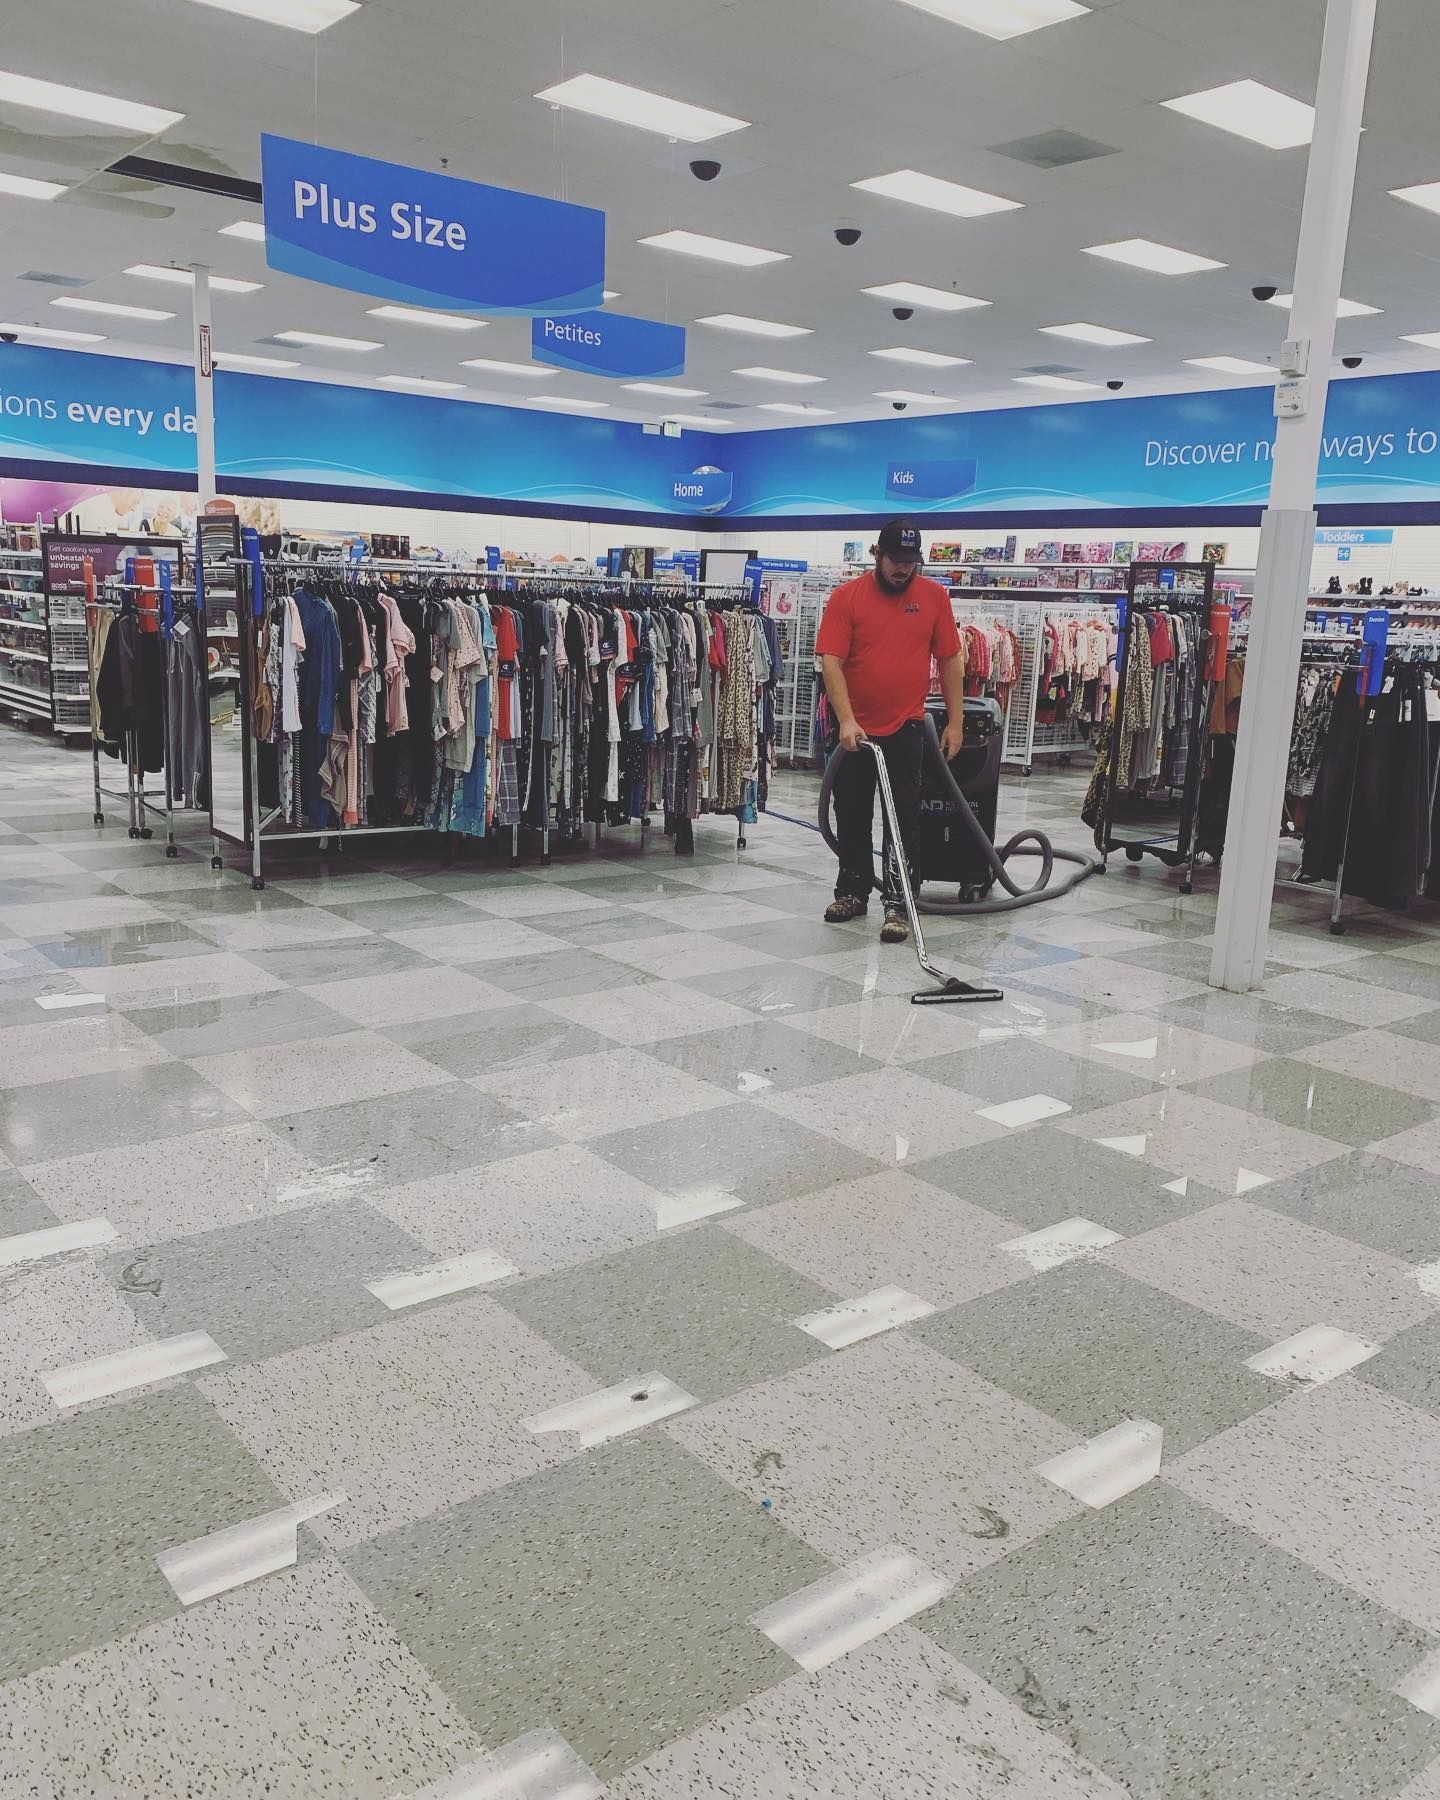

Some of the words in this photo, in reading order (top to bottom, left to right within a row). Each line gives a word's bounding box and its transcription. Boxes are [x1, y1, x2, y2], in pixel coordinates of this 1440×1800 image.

[294, 180, 377, 233] Plus
[391, 202, 467, 251] Size
[544, 319, 602, 346] Petites
[67, 402, 154, 435] every
[163, 406, 215, 434] da
[1145, 440, 1247, 467] Discover
[1323, 431, 1394, 464] ways
[1406, 427, 1438, 454] to
[893, 471, 914, 484] Kids
[673, 482, 704, 497] Home
[1322, 530, 1365, 542] Toddlers
[63, 546, 88, 554] cooking
[51, 562, 79, 570] savings
